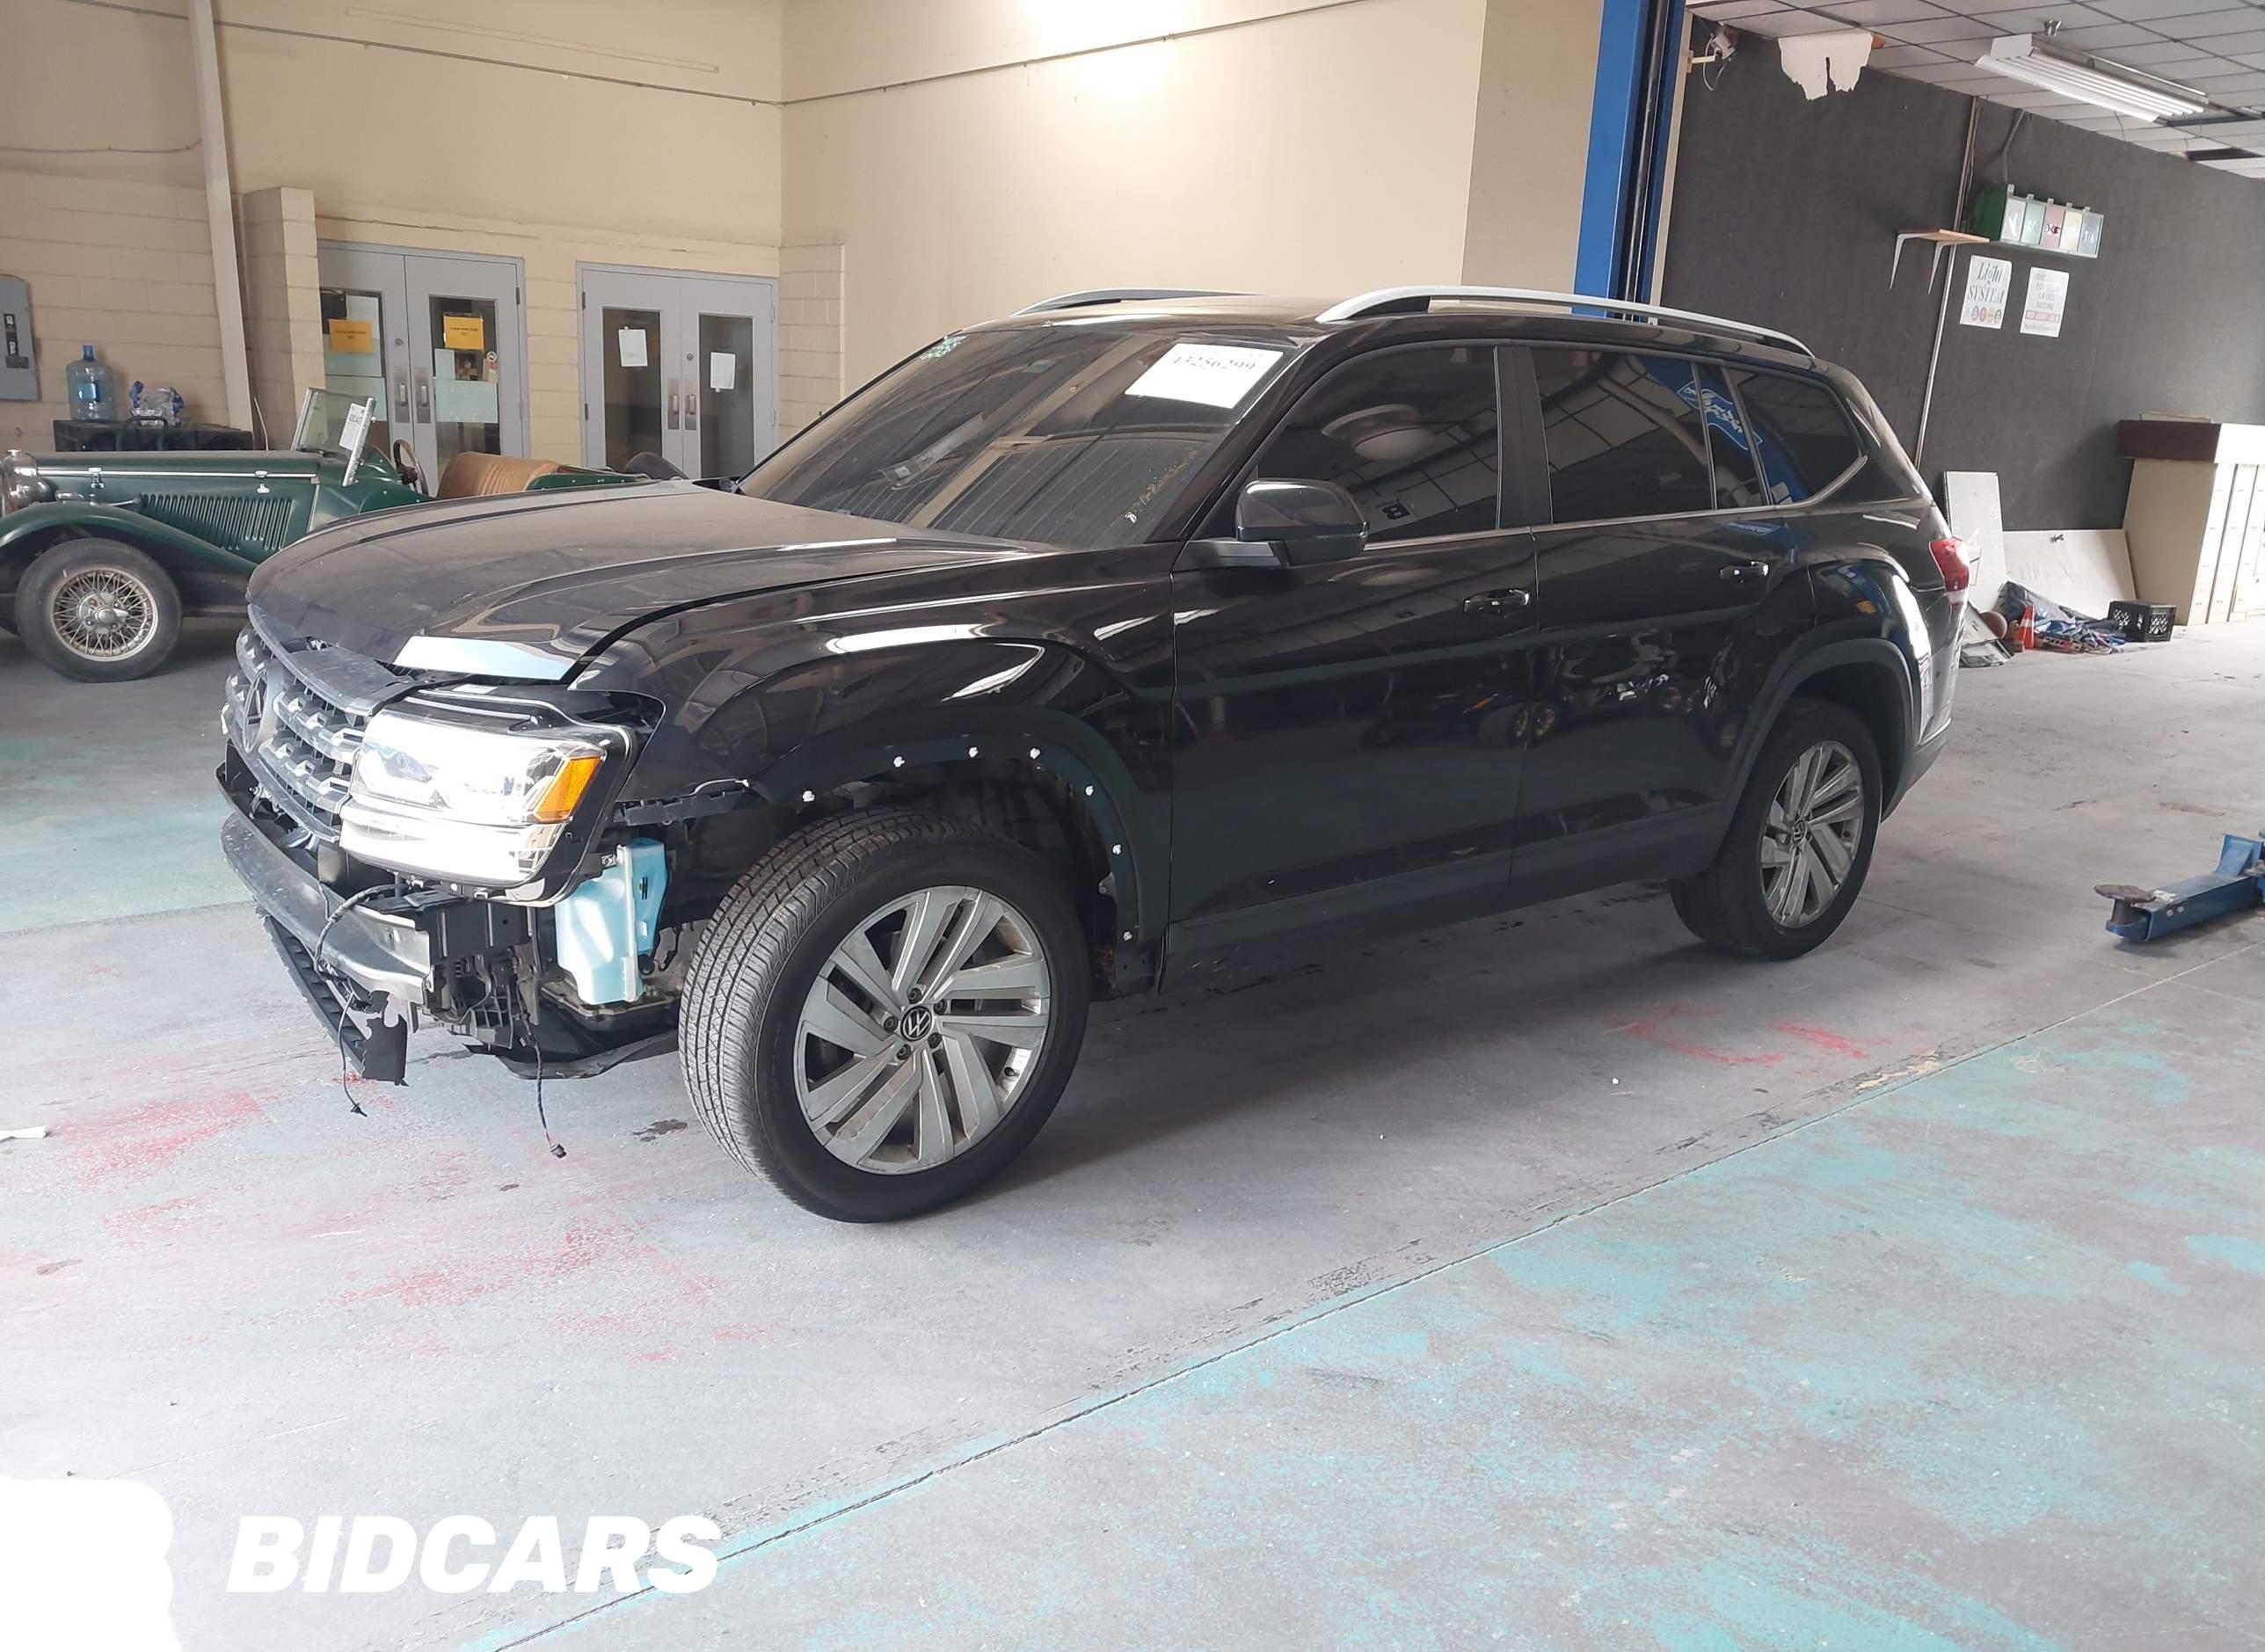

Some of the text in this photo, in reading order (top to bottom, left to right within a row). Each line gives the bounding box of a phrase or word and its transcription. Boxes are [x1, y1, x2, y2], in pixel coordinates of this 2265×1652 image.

[1977, 262, 2003, 287] Light
[1967, 285, 2005, 304] SYSTEM
[903, 1009, 931, 1039] VW
